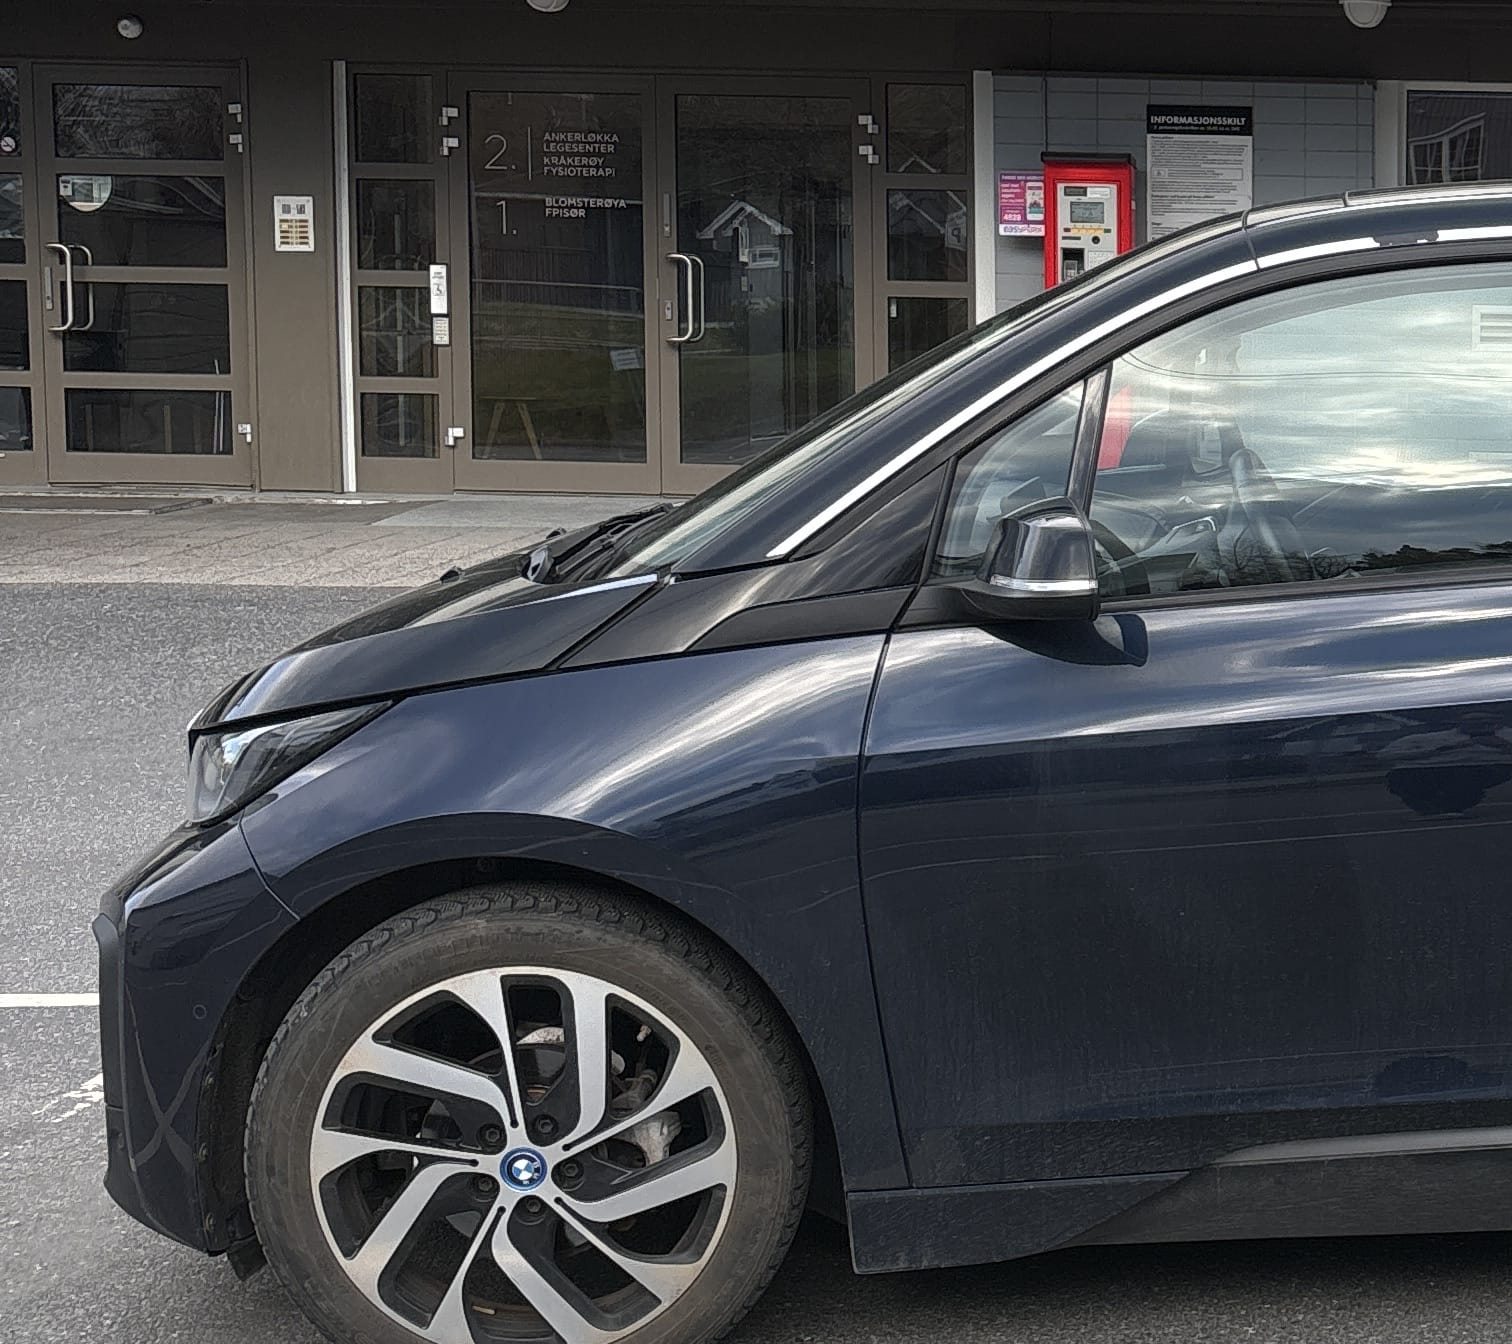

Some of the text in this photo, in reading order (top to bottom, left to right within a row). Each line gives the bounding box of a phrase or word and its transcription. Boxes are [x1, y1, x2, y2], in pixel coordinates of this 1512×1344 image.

[1150, 115, 1246, 126] INFORMASJONSSKILT
[543, 132, 620, 143] ANKERLØKKA
[484, 134, 517, 170] 2.
[543, 143, 615, 153] LEGESENTER
[543, 155, 605, 166] KRÅKERØY
[543, 167, 616, 177] FYSIOTERAPI
[545, 197, 627, 209] BLOMSTERØYA
[496, 200, 518, 235] 1.
